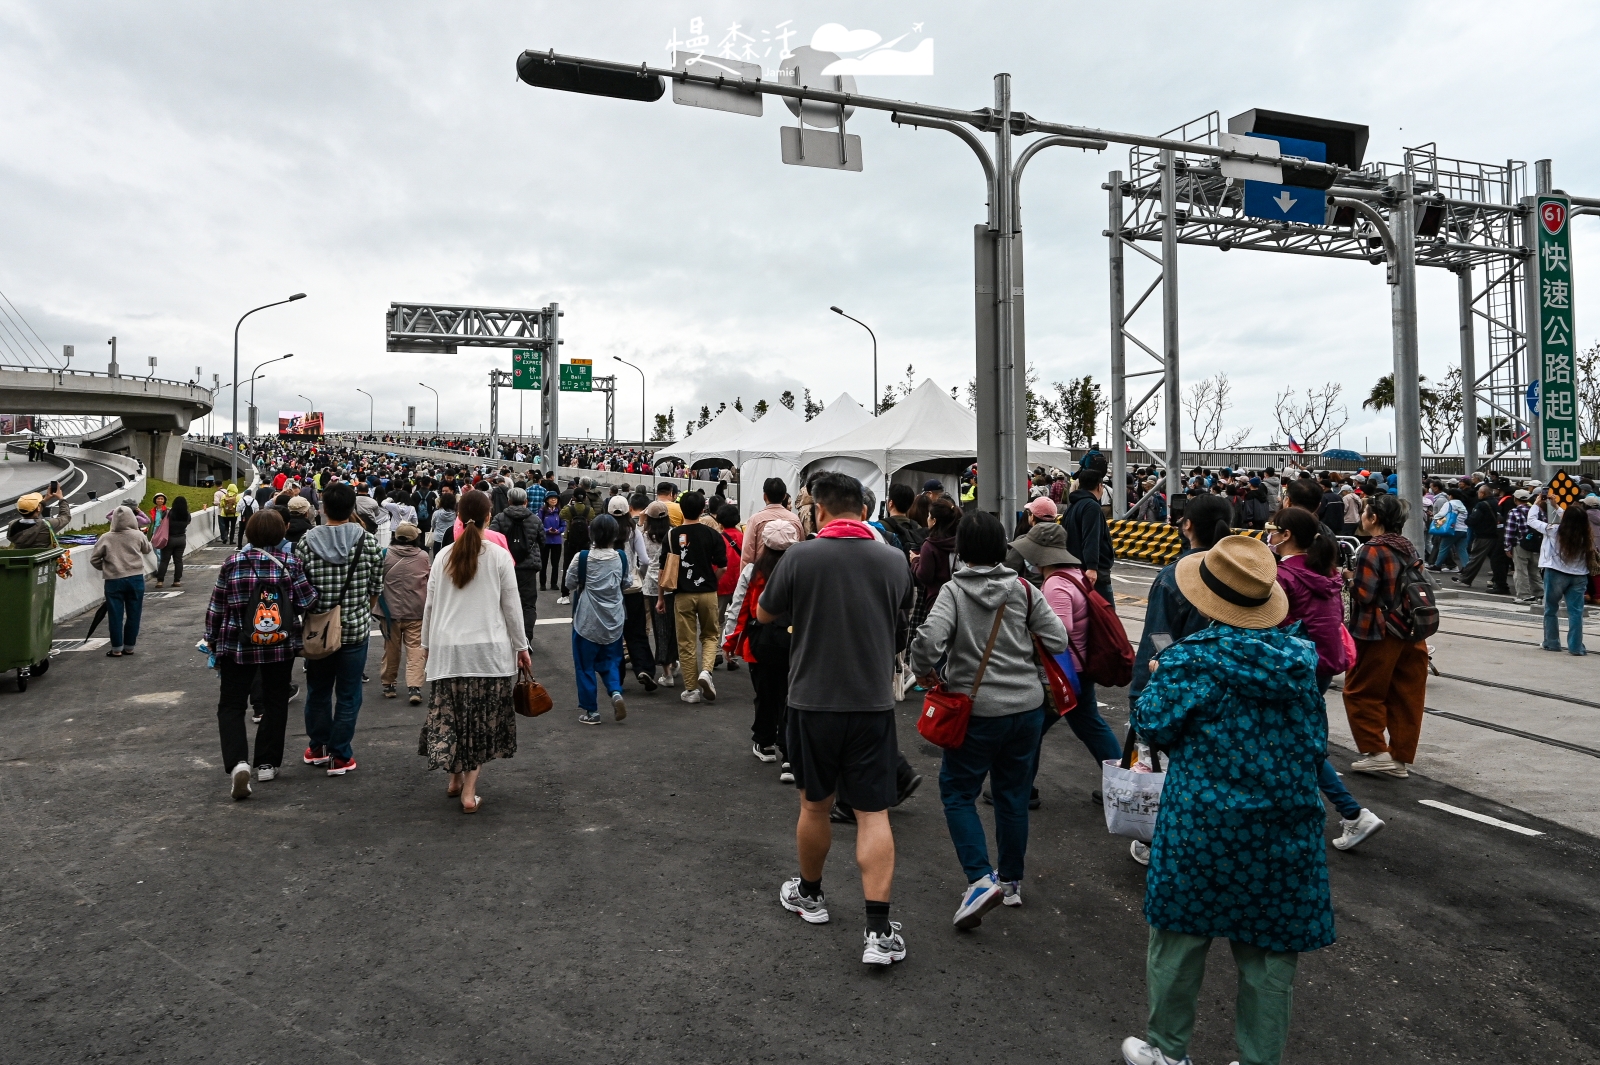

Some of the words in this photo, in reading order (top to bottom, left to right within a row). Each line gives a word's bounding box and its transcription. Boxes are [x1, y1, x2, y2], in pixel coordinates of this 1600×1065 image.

[1545, 207, 1561, 222] 61
[1542, 241, 1574, 459] 快速公路起點
[523, 352, 542, 360] 快速
[566, 366, 586, 374] 八里
